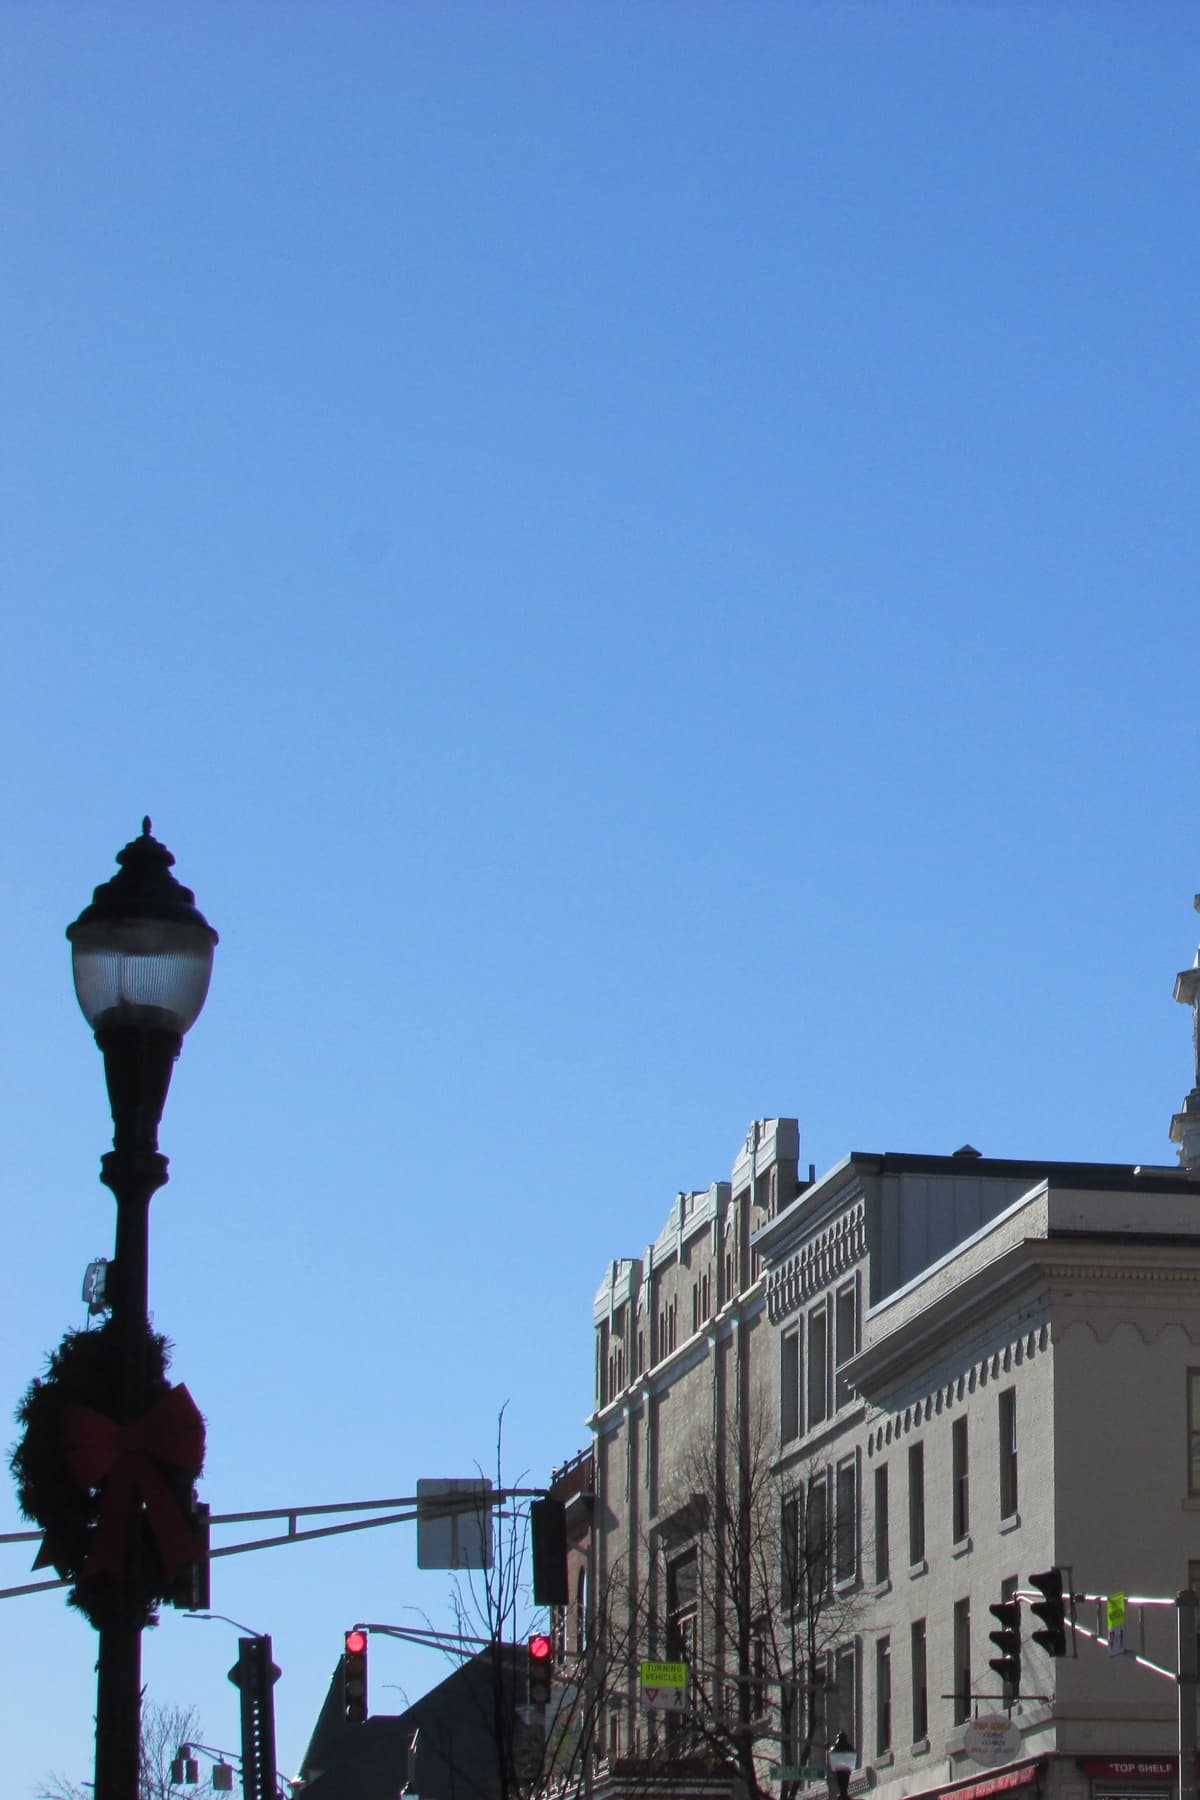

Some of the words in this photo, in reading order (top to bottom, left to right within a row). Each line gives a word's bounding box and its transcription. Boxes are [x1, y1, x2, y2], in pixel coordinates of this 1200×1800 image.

[647, 1664, 682, 1672] TURNING
[646, 1672, 684, 1681] VEHICLES
[1137, 1763, 1172, 1773] SHELF
